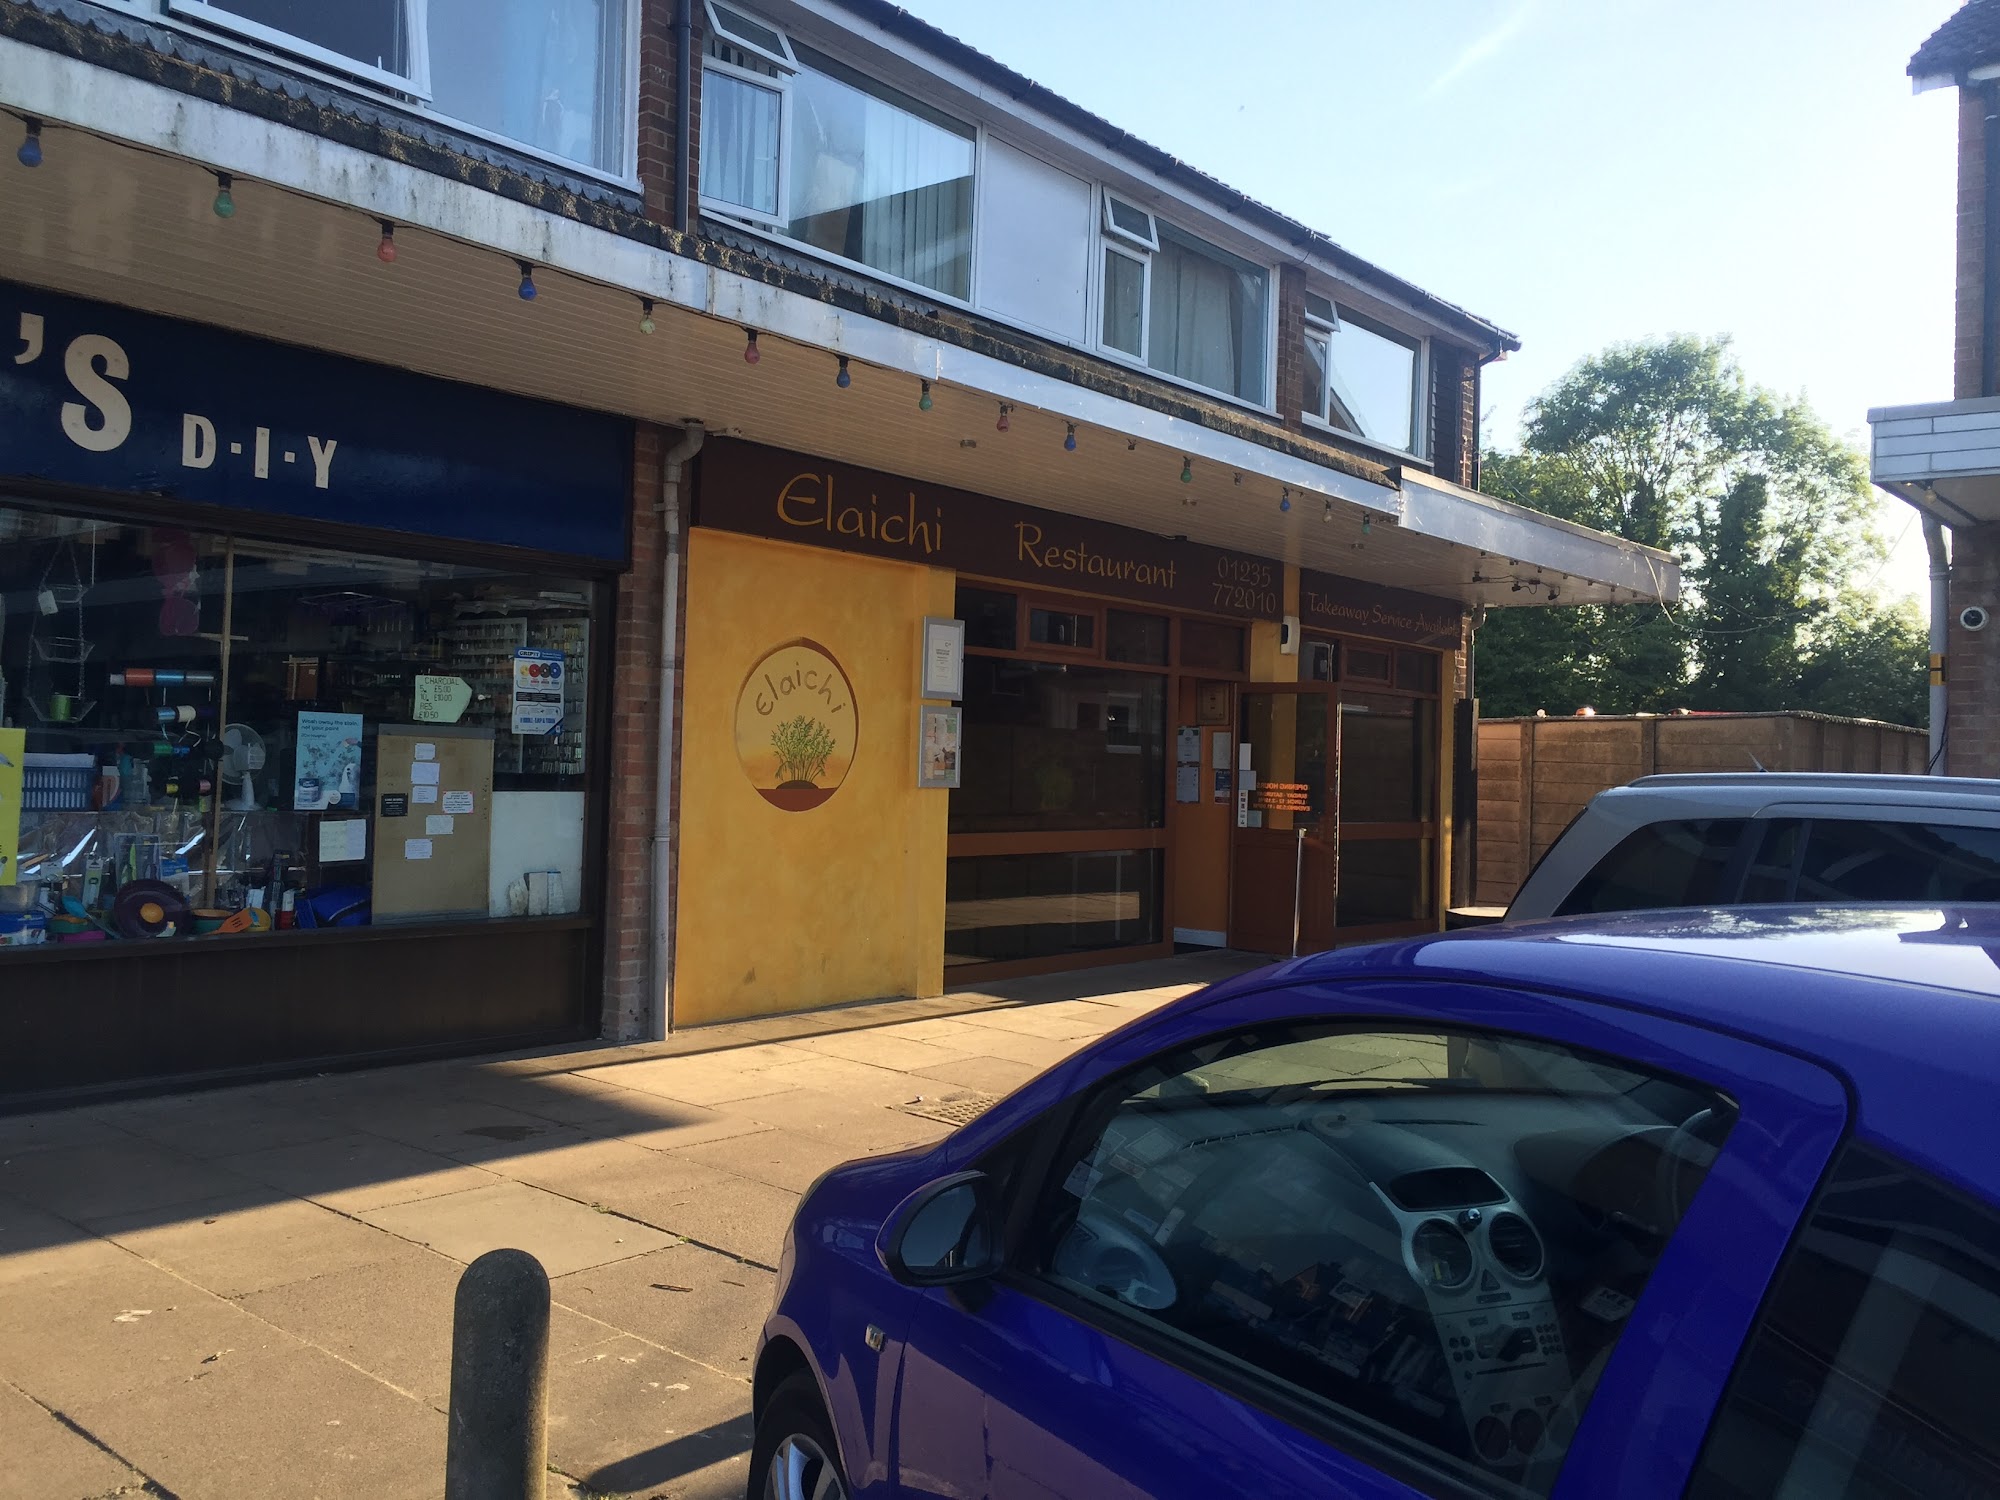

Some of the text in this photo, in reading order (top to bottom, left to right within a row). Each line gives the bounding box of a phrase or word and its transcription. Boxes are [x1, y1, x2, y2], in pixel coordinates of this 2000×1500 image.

[776, 473, 1177, 589] Elaichi Restaurant
[1217, 556, 1271, 588] 01235
[1212, 582, 1276, 614] 772010
[1308, 592, 1460, 637] Takeaway Service Available
[424, 677, 460, 686] CHARCOAL
[755, 661, 846, 717] Elaichi
